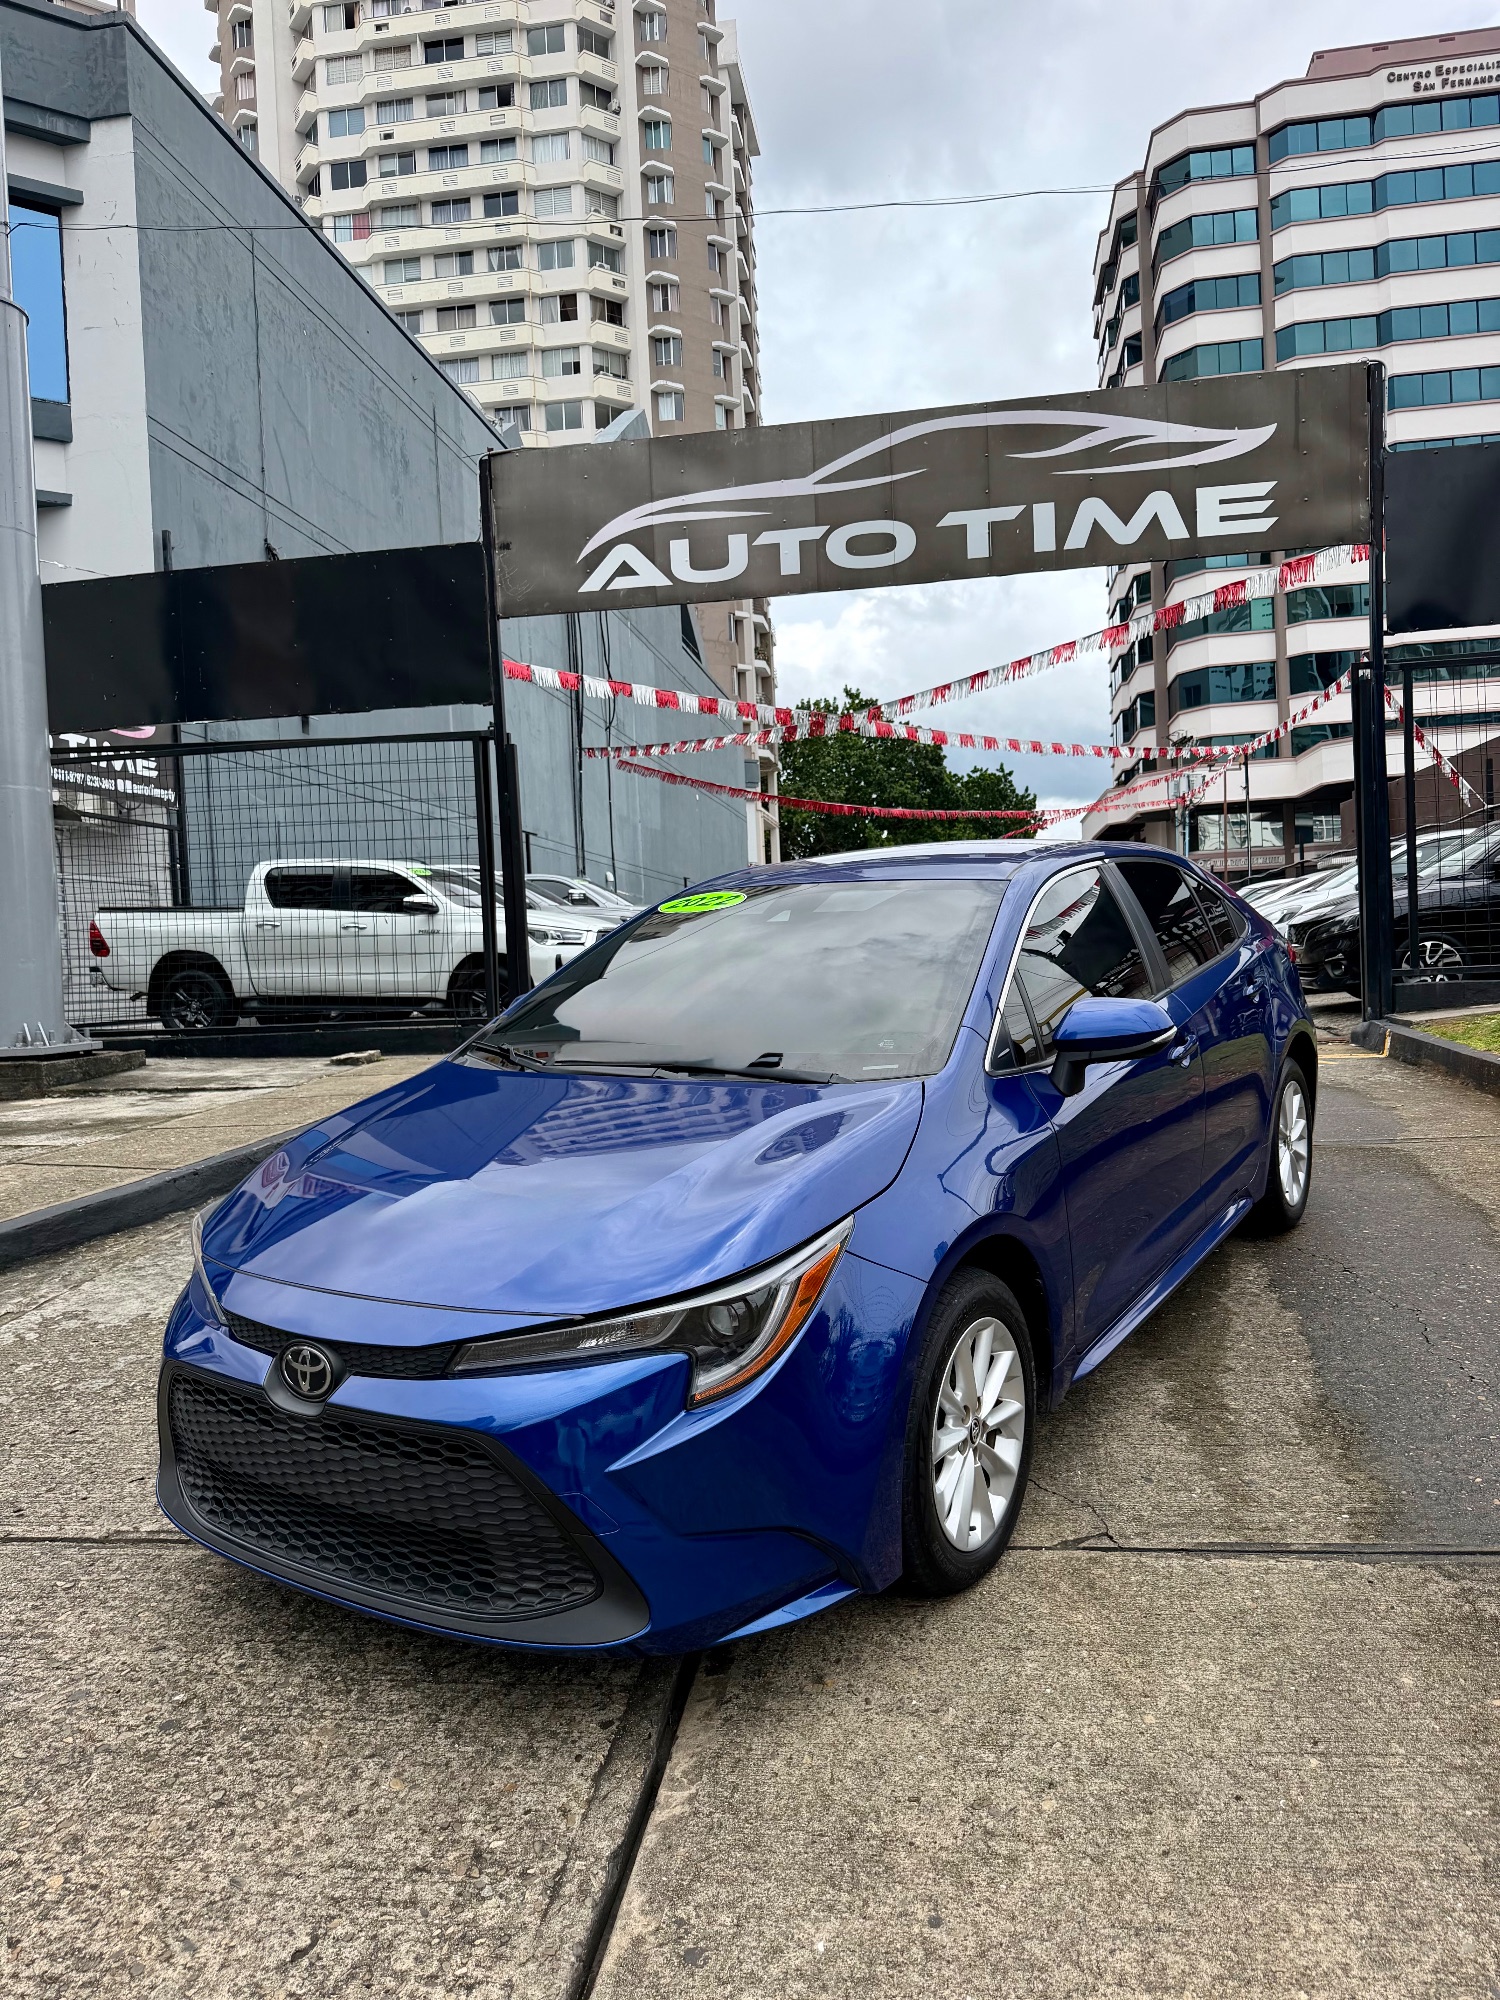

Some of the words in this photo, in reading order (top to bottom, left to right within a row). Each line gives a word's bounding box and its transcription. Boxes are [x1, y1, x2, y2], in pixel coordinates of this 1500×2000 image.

[1387, 70, 1431, 83] CENTRO
[1413, 81, 1435, 92] SAN
[1441, 74, 1500, 89] FERNANDO
[578, 519, 917, 593] AUTO
[935, 480, 1280, 560] TIME
